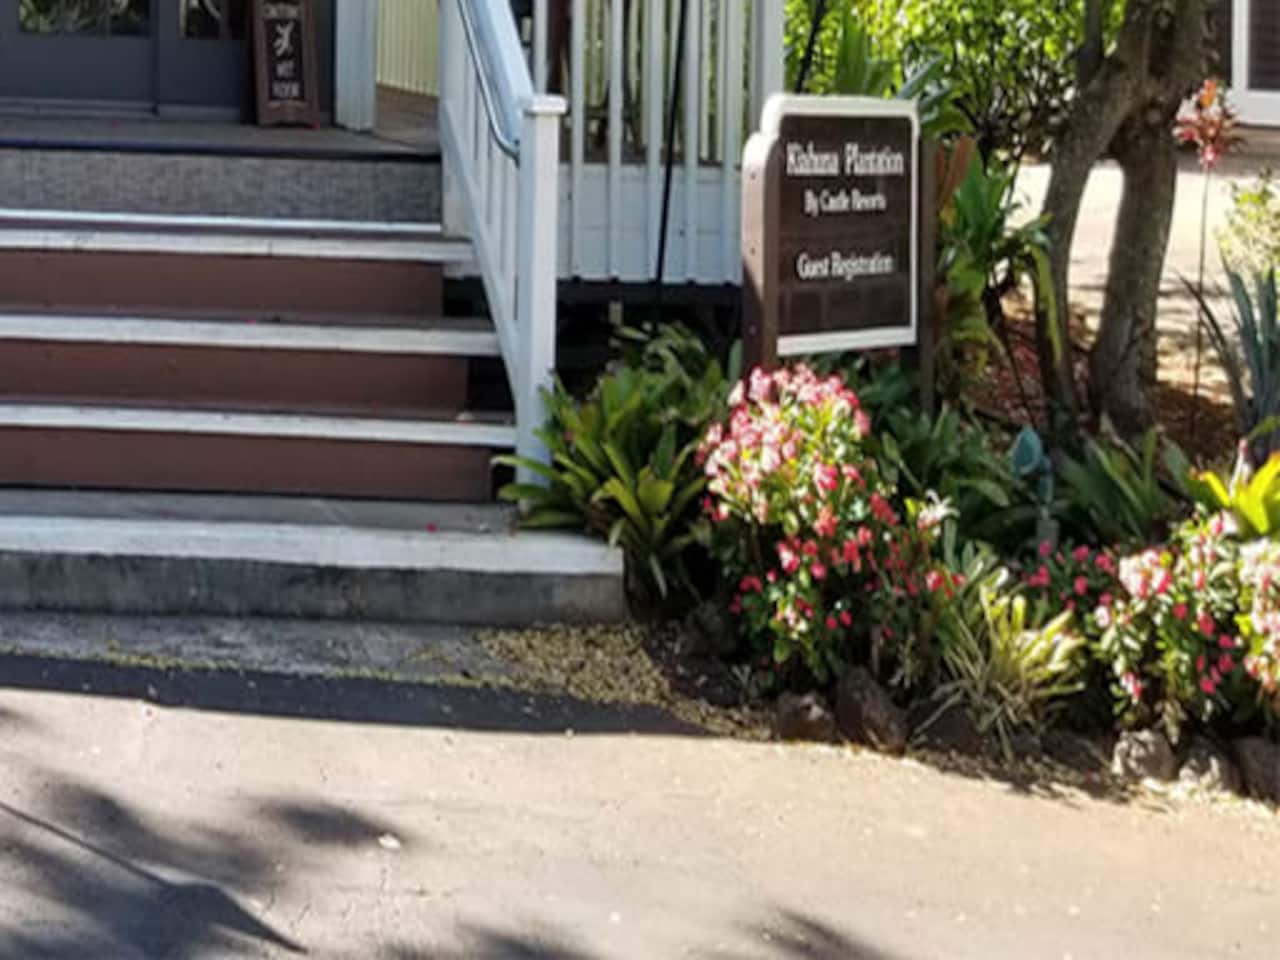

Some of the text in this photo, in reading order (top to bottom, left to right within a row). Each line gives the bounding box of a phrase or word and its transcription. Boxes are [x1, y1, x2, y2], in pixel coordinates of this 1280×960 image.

[844, 143, 904, 175] Plantation
[804, 189, 818, 216] By
[797, 252, 894, 281] Guest Registration
